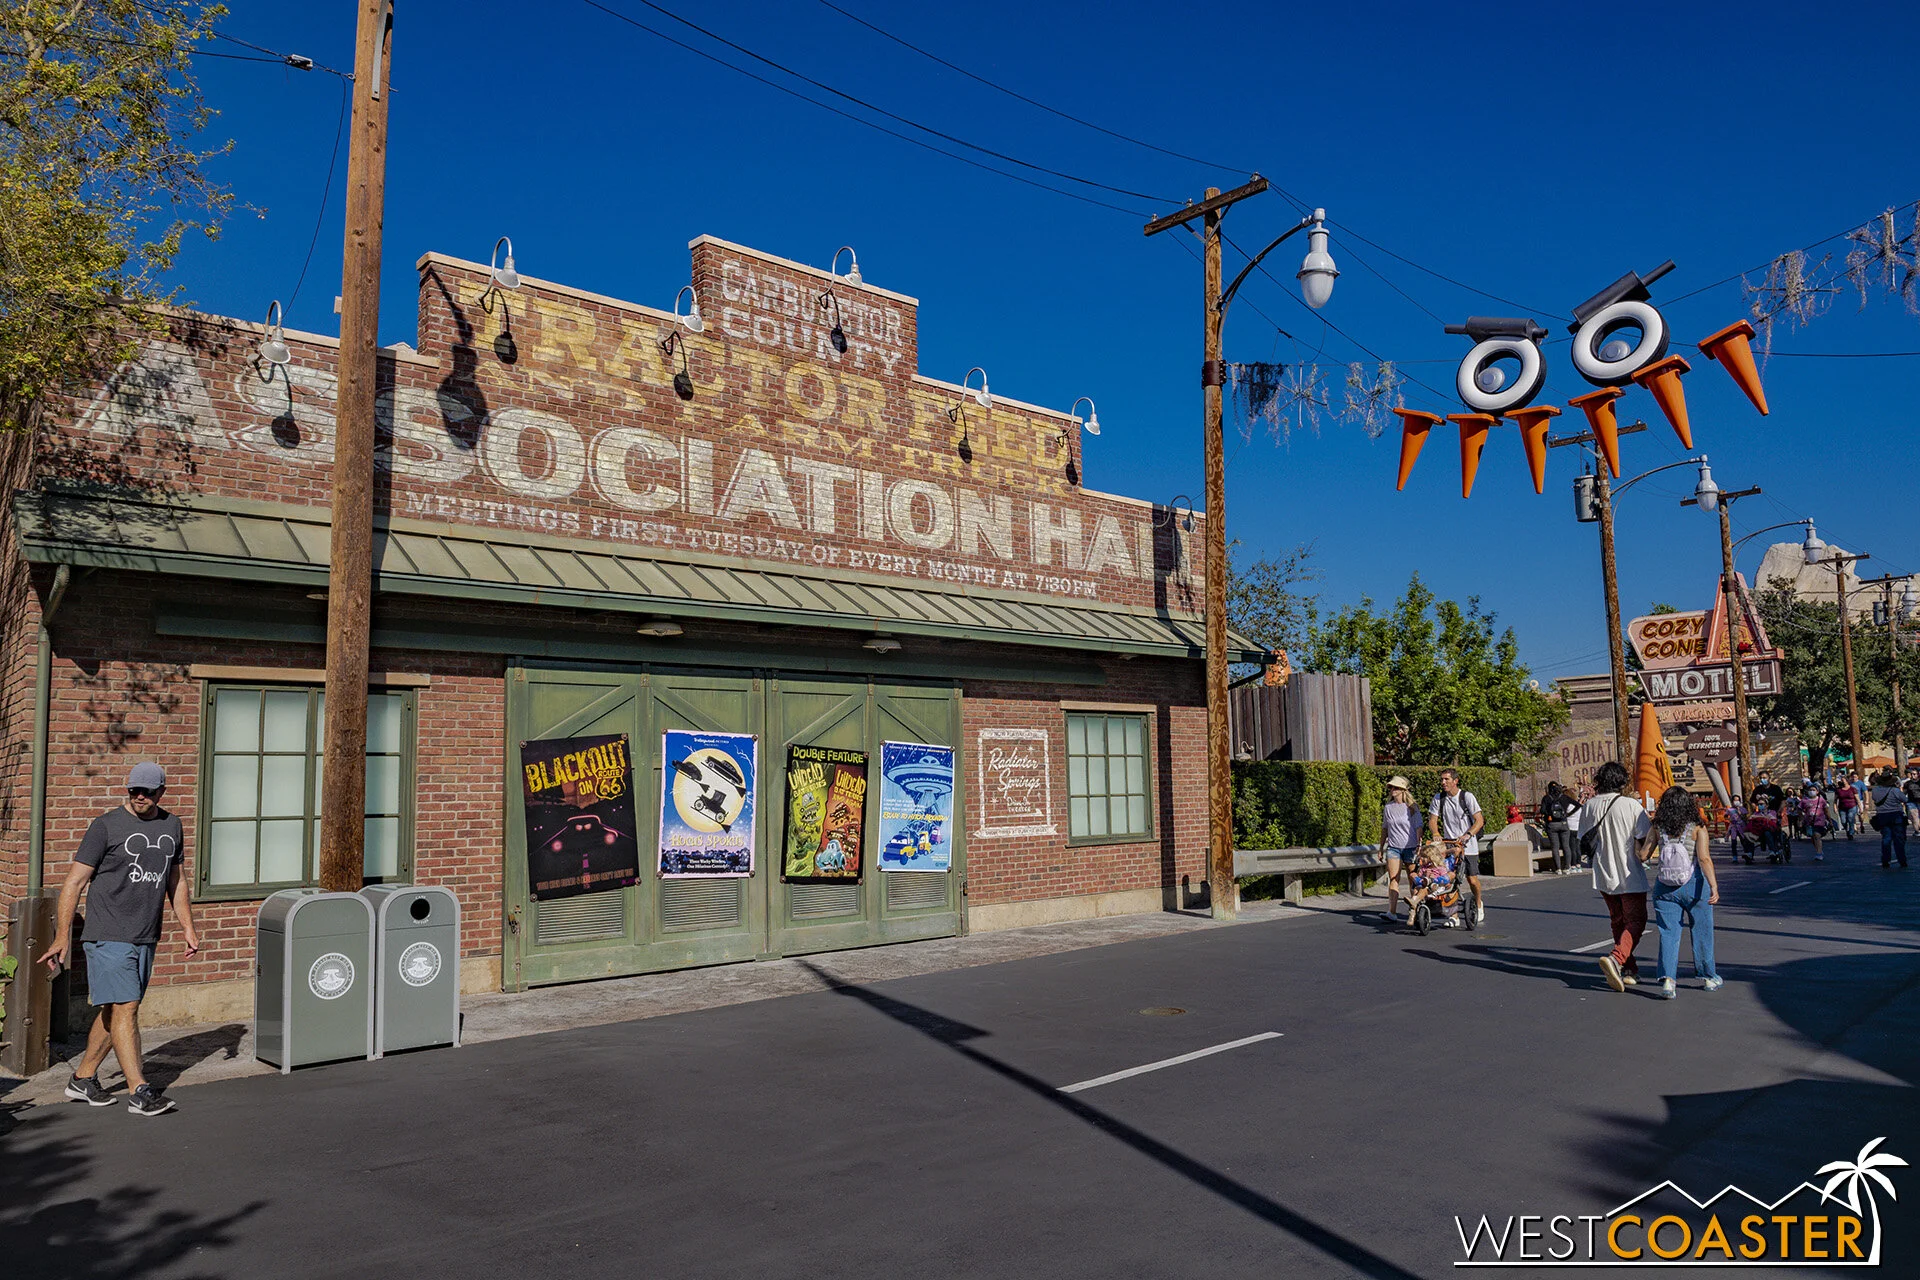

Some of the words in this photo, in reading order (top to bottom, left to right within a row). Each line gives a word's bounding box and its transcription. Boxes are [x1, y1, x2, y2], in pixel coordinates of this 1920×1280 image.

[722, 259, 903, 348] CARBURETOR
[722, 306, 902, 378] COUNTY
[459, 278, 888, 435] TRACTOR
[908, 388, 1070, 470] FEED
[675, 399, 878, 459] FARM
[891, 443, 1073, 498] TRUCK
[75, 340, 1013, 561] ASSOCIATION
[1028, 500, 1206, 590] HALL
[405, 491, 581, 531] MEETINGS
[590, 514, 678, 544] FIRST
[685, 526, 805, 560] TUESDAY
[810, 544, 842, 564] OF
[848, 548, 922, 575] EVERY
[927, 559, 997, 585] MONTH
[1001, 570, 1029, 589] AT
[1641, 617, 1706, 640] COZY
[1642, 637, 1708, 660] CONE
[792, 745, 826, 761] DOUBLE
[827, 749, 864, 764] FEATURE
[987, 746, 1039, 772] Radiator
[1687, 741, 1738, 751] REFRIGERATED
[524, 739, 627, 793] BLACKOUT
[597, 768, 621, 778] ROUTE
[787, 761, 824, 791] UNDEAD
[578, 779, 594, 796] ON
[599, 777, 621, 796] 66
[835, 769, 867, 795] UNDEAD
[996, 767, 1041, 799] Springs
